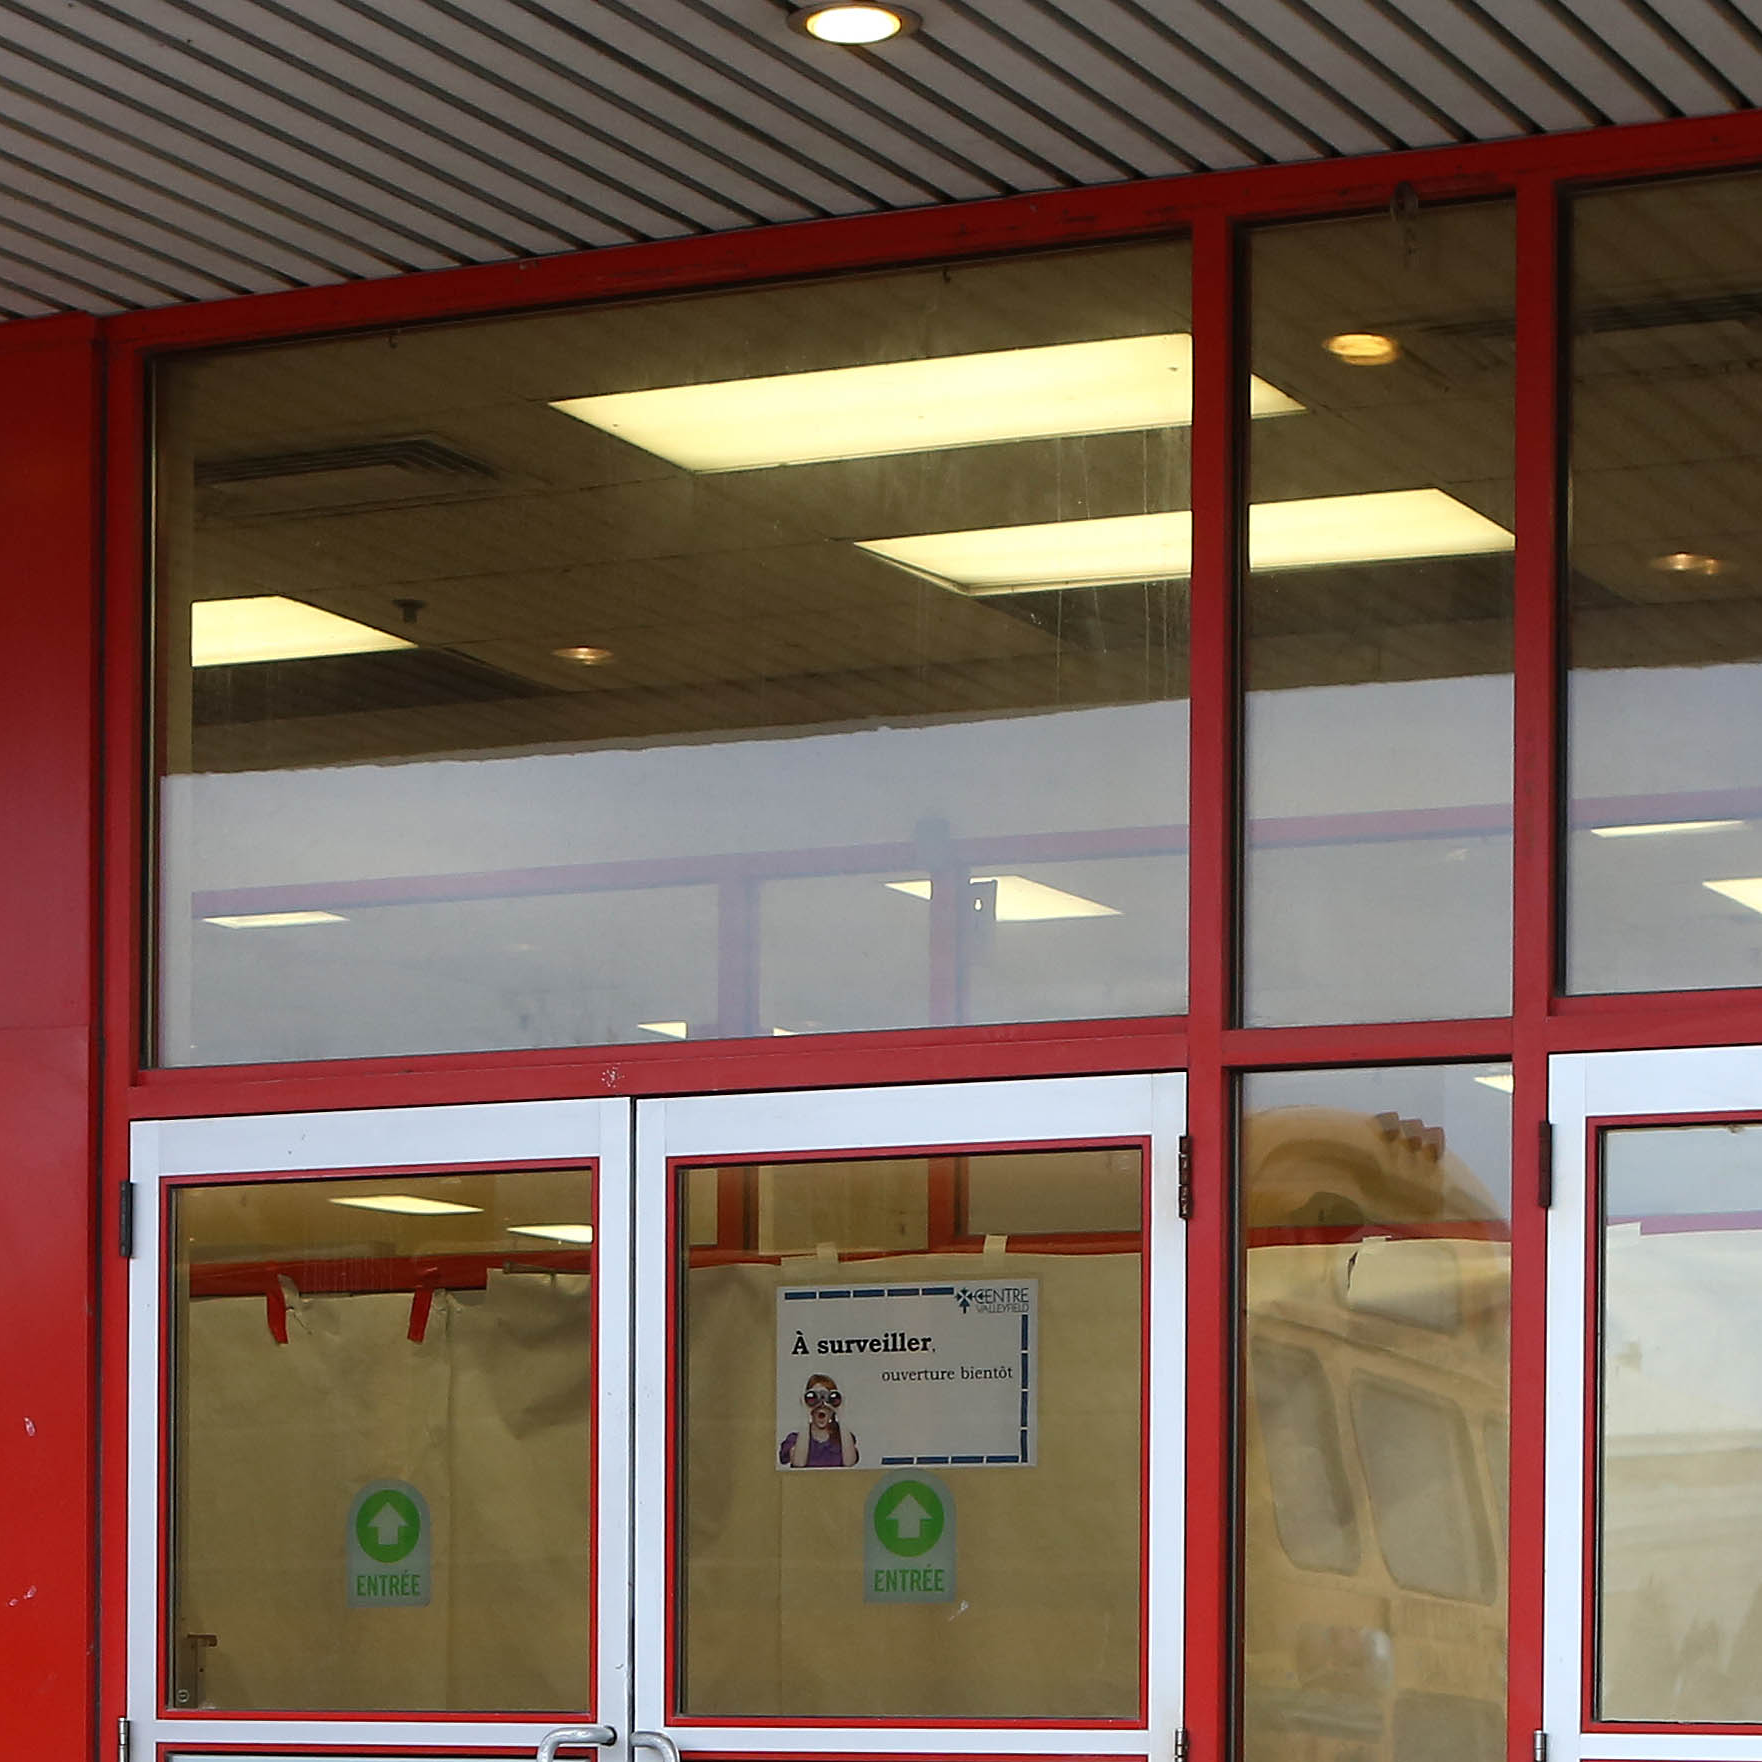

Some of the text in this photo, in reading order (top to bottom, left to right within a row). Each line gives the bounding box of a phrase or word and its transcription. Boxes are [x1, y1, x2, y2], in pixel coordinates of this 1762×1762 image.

[973, 1287, 1030, 1304] CENTRE
[975, 1303, 1030, 1314] VALLEYFIELD
[791, 1330, 810, 1355] À
[881, 1365, 1013, 1382] ouverture bientôt
[357, 1569, 421, 1597] ENTRÉE
[875, 1563, 945, 1592] ENTRÉE
